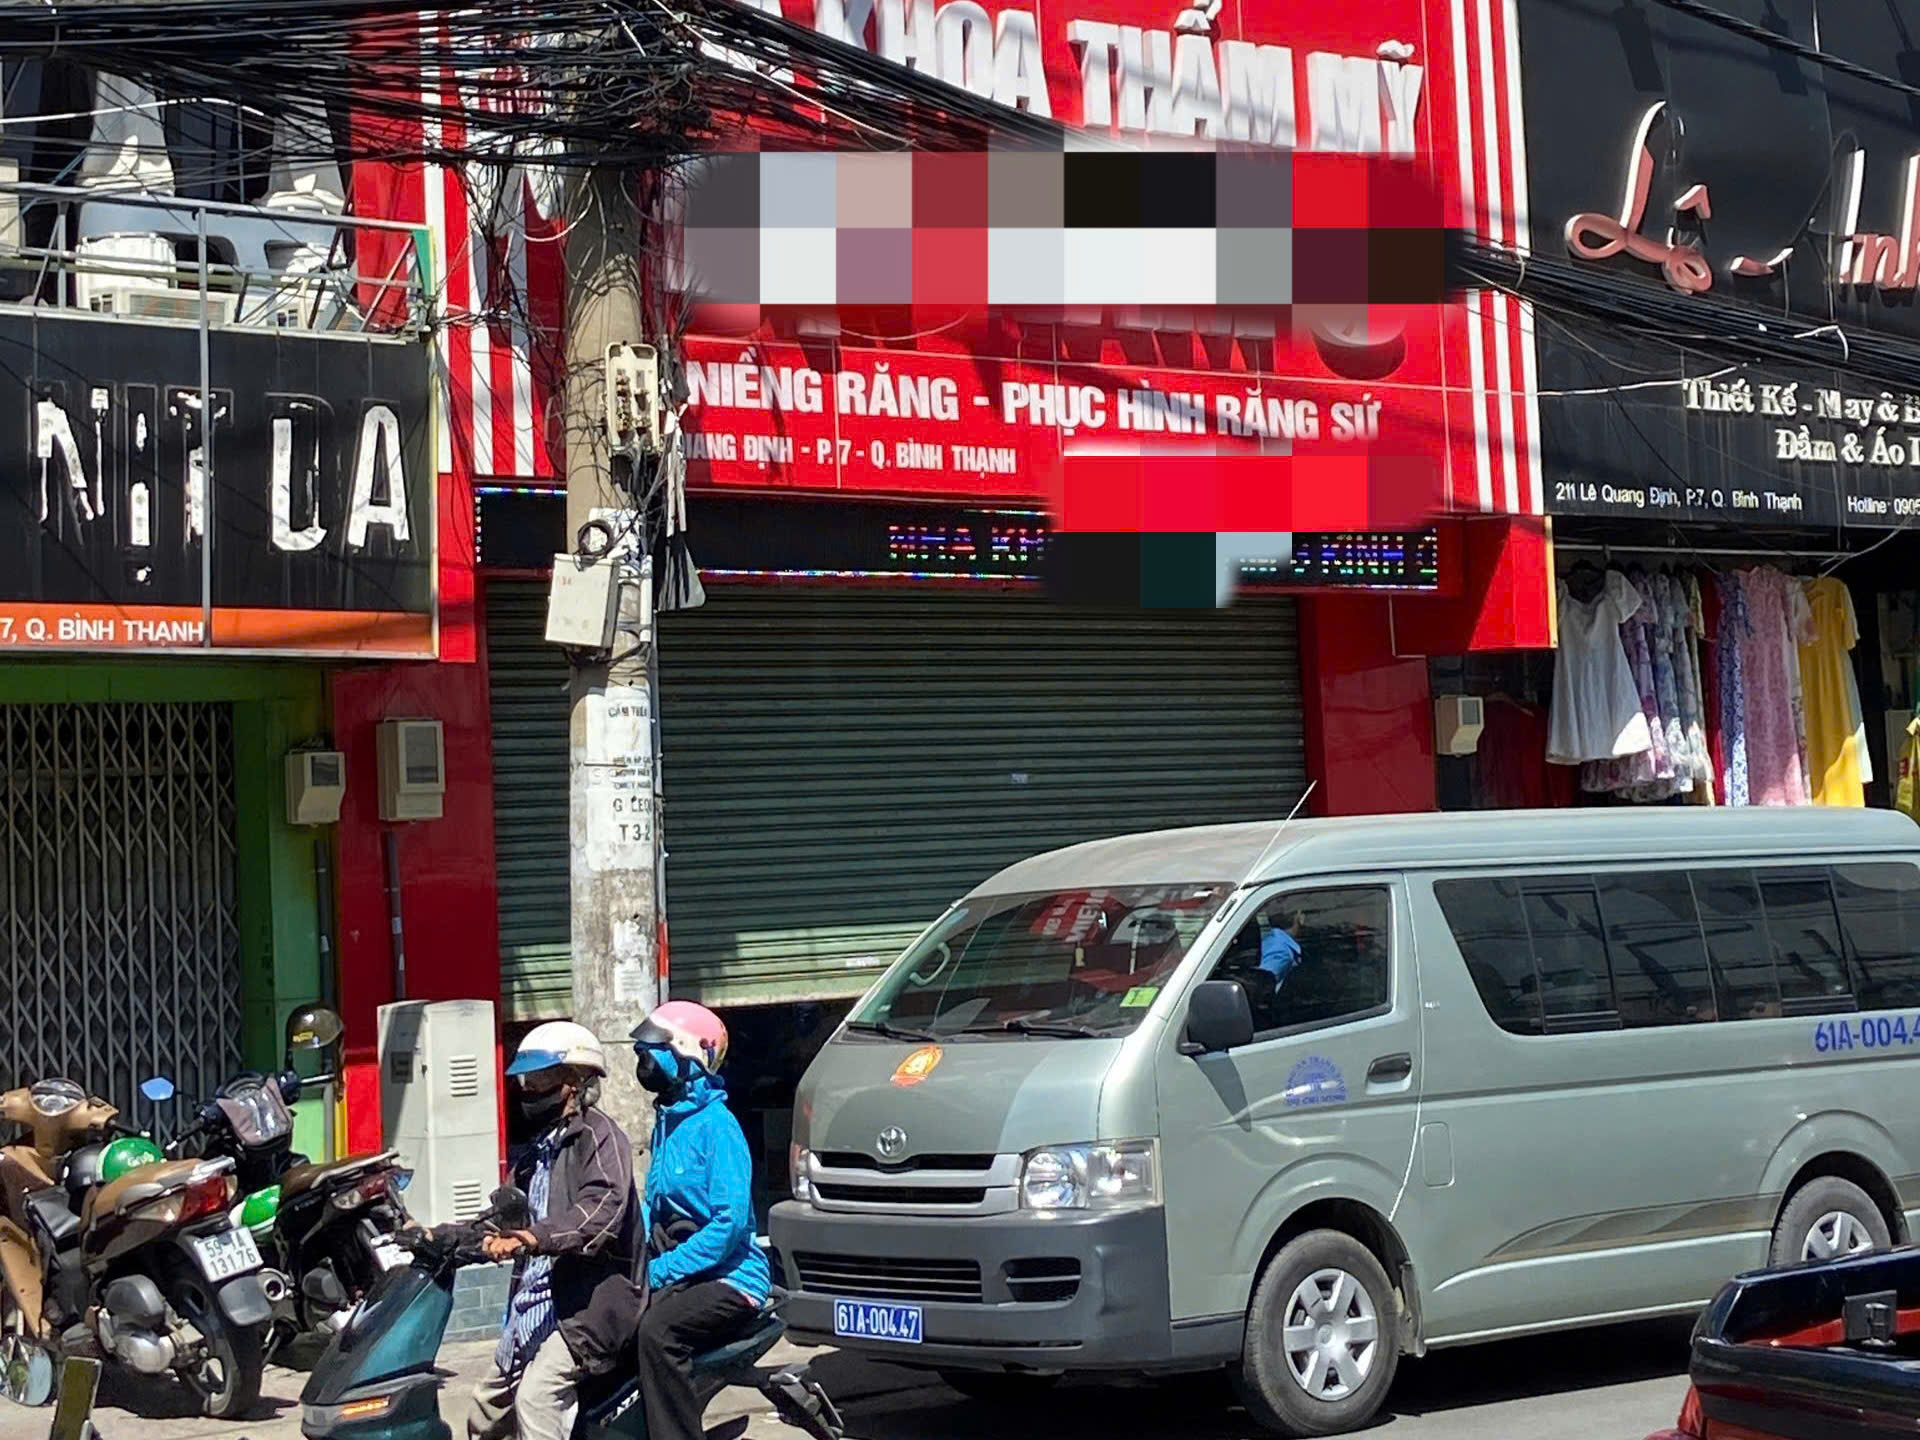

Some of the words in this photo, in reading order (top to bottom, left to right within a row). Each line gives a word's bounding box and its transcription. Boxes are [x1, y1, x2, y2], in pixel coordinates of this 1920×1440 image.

[1066, 0, 1297, 147] THẨM
[1306, 39, 1424, 154] MỸ
[686, 346, 823, 413] NIỀNG
[837, 361, 960, 421] RĂNG
[1002, 381, 1106, 437] PHỤC
[1118, 379, 1207, 434] HÌNH
[1216, 386, 1320, 439] RĂNG
[1681, 377, 1756, 413] Thiết
[1759, 381, 1799, 417] Kế
[1815, 388, 1875, 427] May
[1876, 392, 1900, 423] &
[743, 435, 794, 469] ĐỊNH
[872, 440, 891, 469] Q.
[896, 437, 943, 469] BÌNH
[952, 444, 1017, 479] THẠNH
[1775, 425, 1838, 462] Đầm
[1840, 432, 1865, 463] &
[1869, 426, 1905, 466] Áo
[1555, 482, 1576, 500] 211
[1580, 483, 1597, 501] Lê
[1601, 484, 1645, 508] Quang
[1763, 492, 1803, 513] Thạnh
[25, 617, 54, 641] Q.
[58, 612, 115, 641] BÌNH
[123, 619, 204, 647] THẠNH
